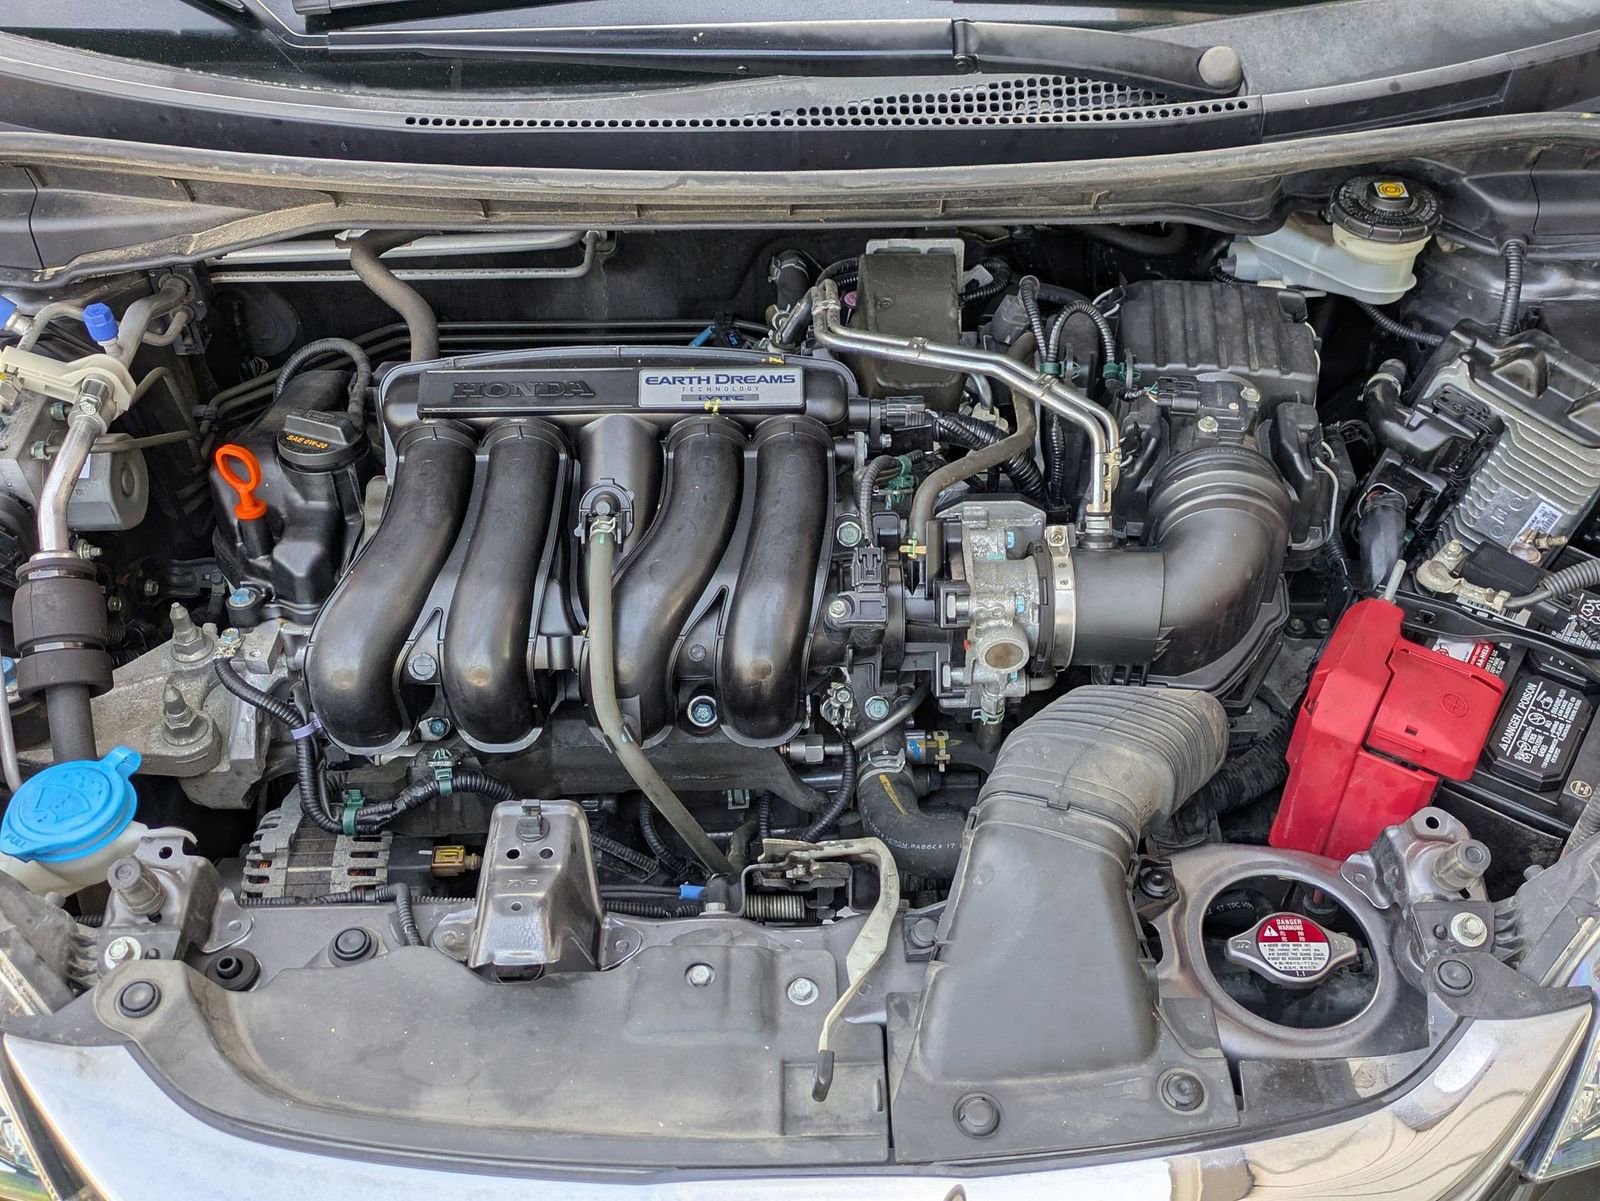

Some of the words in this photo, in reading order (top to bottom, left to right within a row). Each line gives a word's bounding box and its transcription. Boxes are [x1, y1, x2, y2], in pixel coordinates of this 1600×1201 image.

[644, 374, 710, 385] EARTH
[715, 374, 796, 384] DREAMS
[453, 380, 596, 398] HONDA
[286, 434, 304, 444] SAE
[304, 438, 328, 449] 0W-20
[1504, 713, 1522, 744] DANGER
[1518, 682, 1537, 710] POISON
[4, 834, 26, 849] PULL
